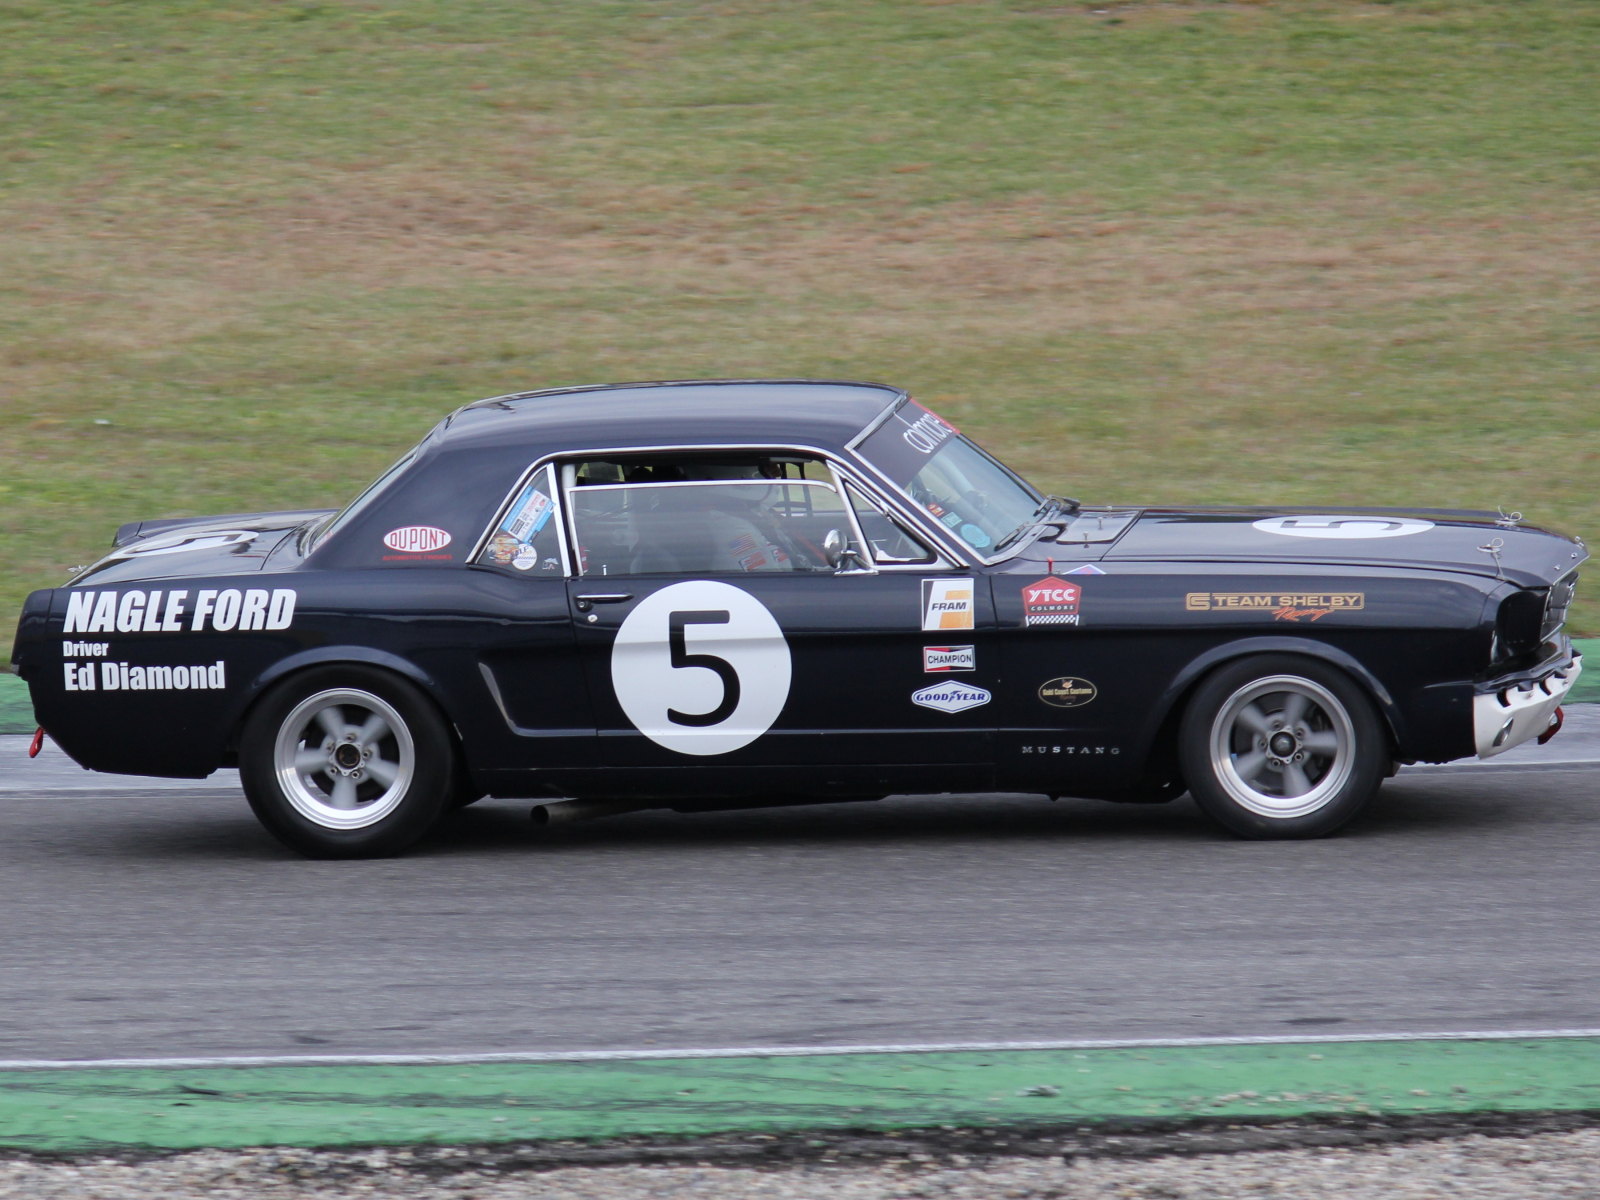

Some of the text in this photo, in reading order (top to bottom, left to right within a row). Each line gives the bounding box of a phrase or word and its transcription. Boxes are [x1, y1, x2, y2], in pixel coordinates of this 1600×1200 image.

[390, 528, 446, 550] DUPONT
[1028, 588, 1076, 602] YTCC
[1214, 596, 1271, 606] TEAM
[1279, 596, 1359, 606] SHELBY
[63, 588, 297, 633] NAGLE FORD
[931, 602, 967, 611] FRAM
[62, 640, 109, 657] Driver
[927, 654, 972, 664] CHAMPION
[63, 660, 226, 691] Ed Diamond
[667, 609, 741, 728] 5
[1022, 746, 1120, 754] MUSTANG
